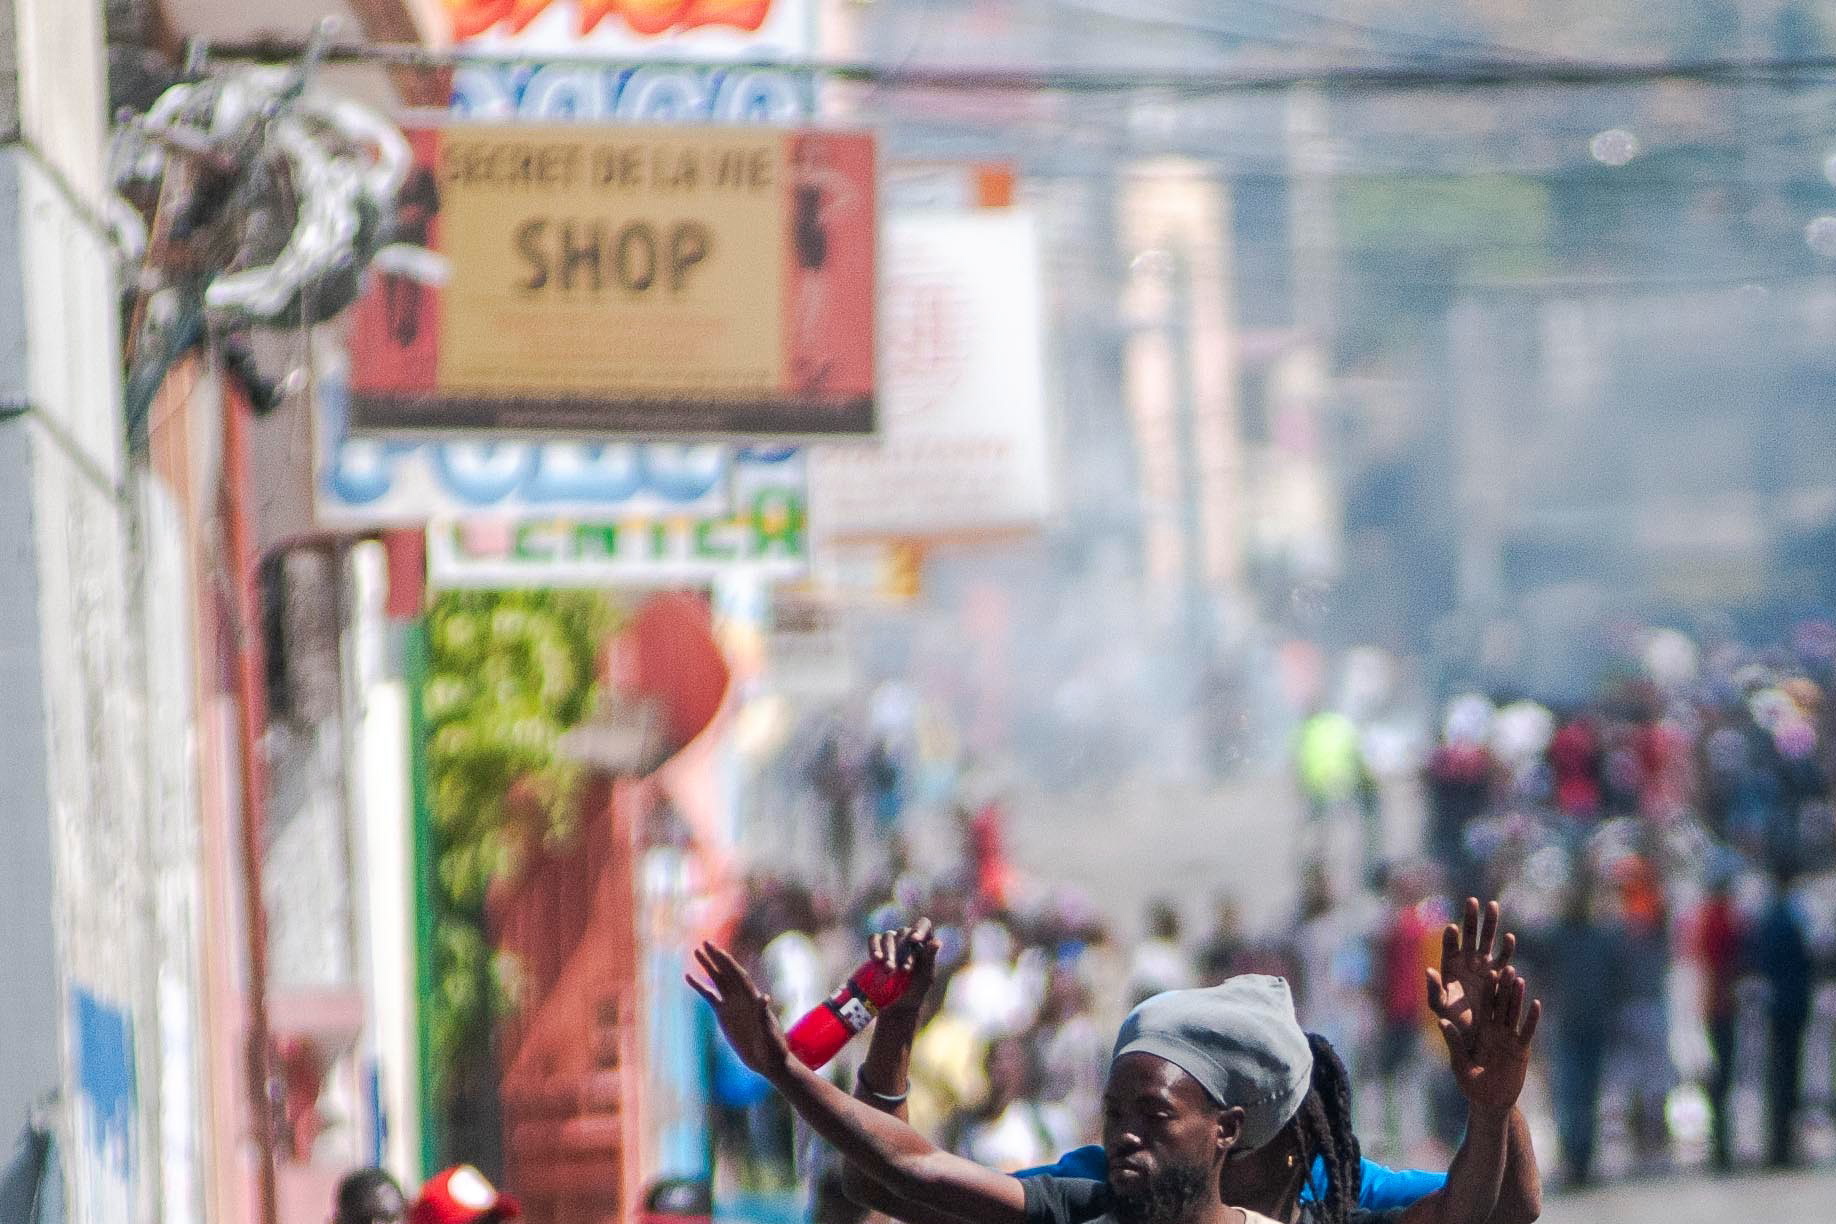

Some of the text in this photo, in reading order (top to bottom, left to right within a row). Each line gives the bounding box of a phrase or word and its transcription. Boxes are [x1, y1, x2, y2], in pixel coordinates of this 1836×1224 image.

[442, 143, 775, 188] SECRET DE LA VIE
[512, 217, 715, 294] SHOP
[453, 487, 807, 563] ENTER
